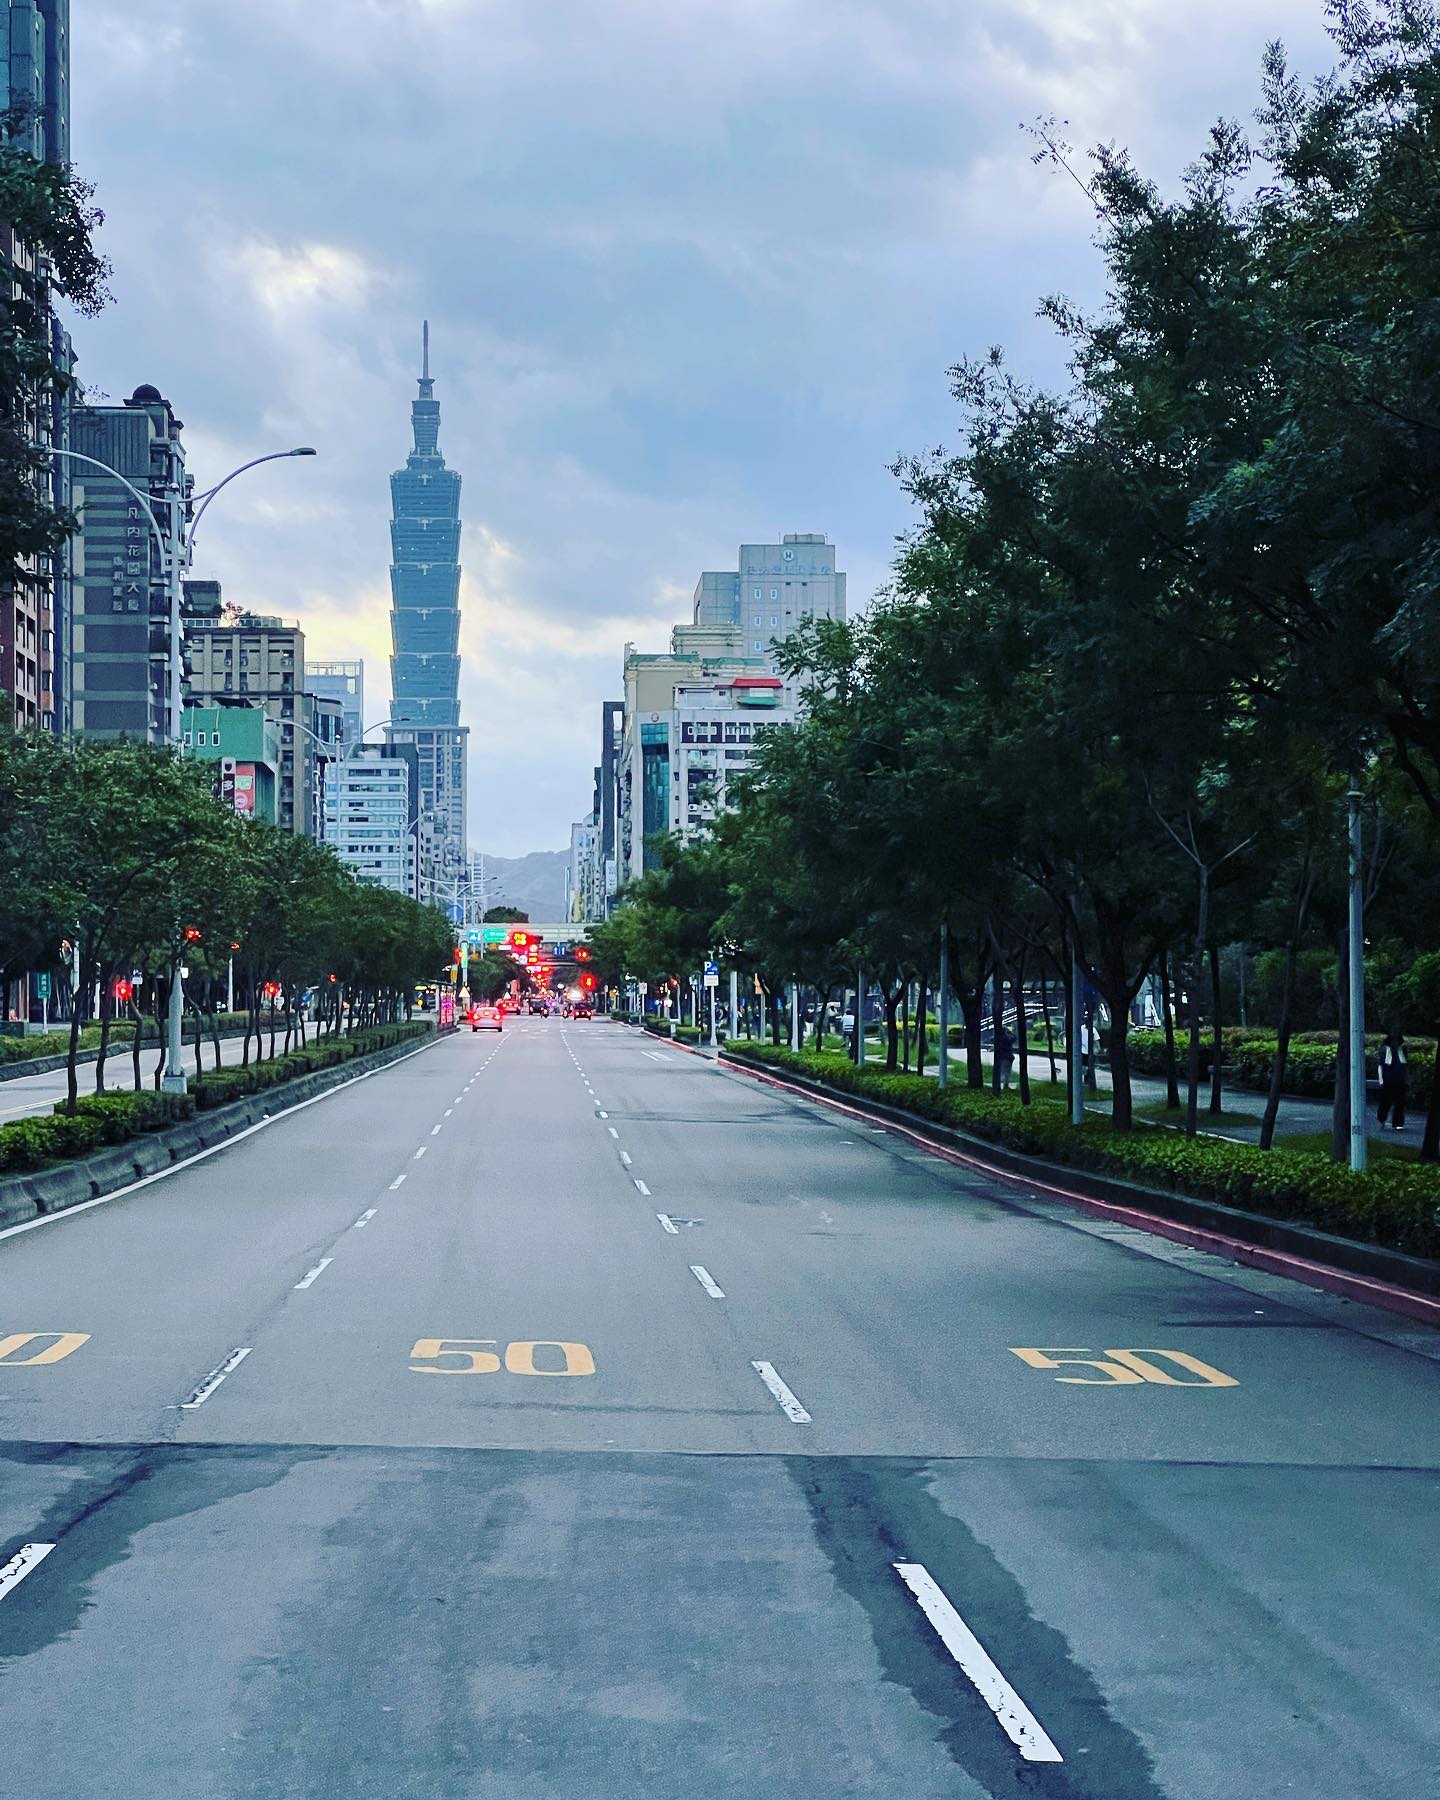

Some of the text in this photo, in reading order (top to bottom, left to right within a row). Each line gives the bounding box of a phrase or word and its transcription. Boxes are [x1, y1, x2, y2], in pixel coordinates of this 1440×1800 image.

[704, 961, 712, 972] P
[408, 1338, 596, 1376] 50
[1007, 1347, 1241, 1388] 50
